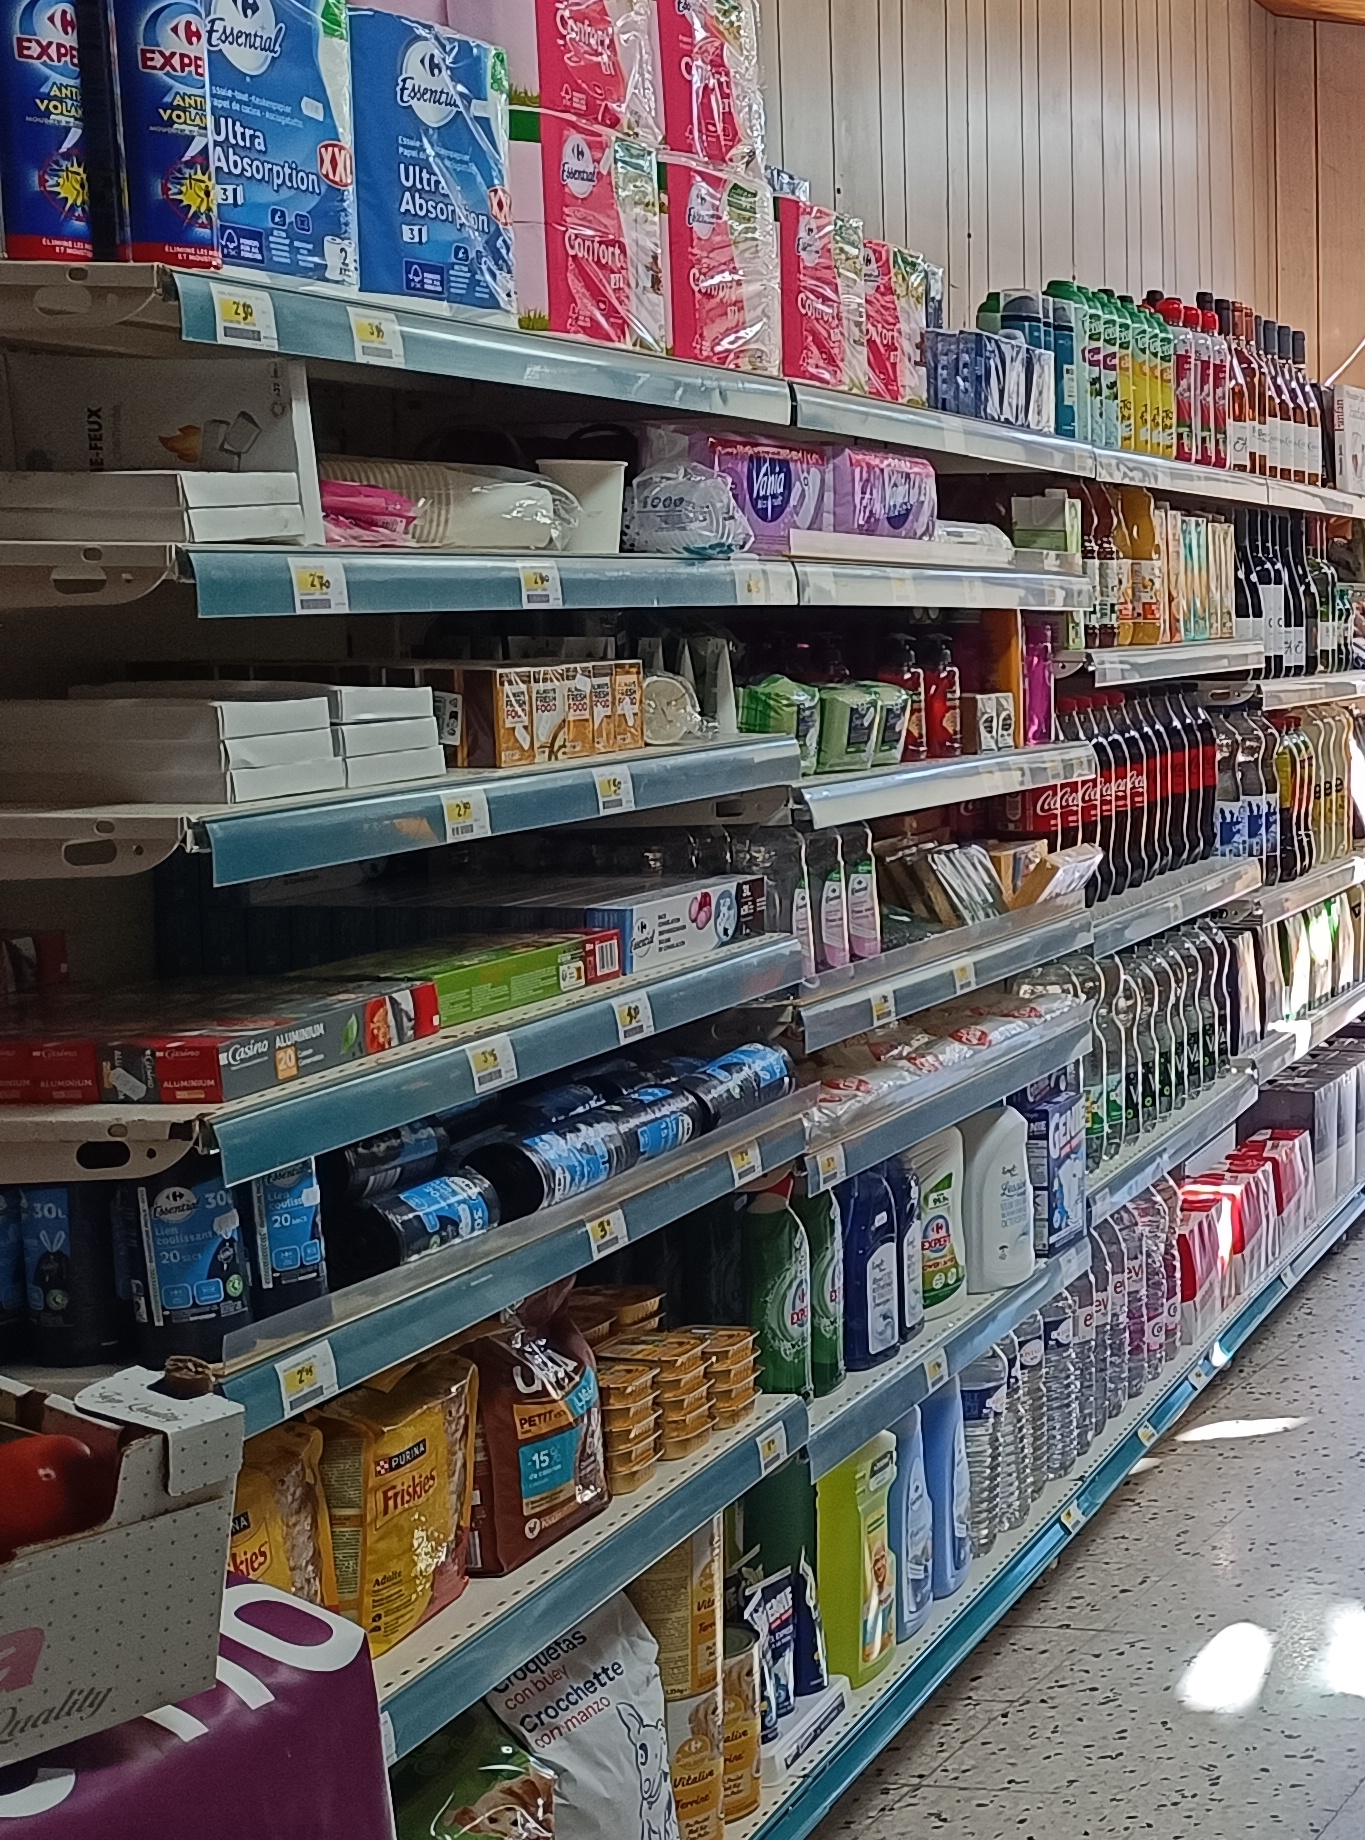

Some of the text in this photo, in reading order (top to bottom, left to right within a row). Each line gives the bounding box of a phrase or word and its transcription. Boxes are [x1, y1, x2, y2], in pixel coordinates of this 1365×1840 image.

[206, 17, 284, 55] Essential
[17, 38, 80, 67] EXPE
[140, 48, 204, 77] EXPE
[211, 115, 266, 153] Ultra
[214, 146, 321, 195] Absorption
[400, 163, 449, 196] Ultra
[275, 1022, 325, 1049] ALUMINIUM
[228, 1038, 269, 1065] Casino
[277, 1050, 296, 1071] 20
[163, 1079, 215, 1089] ALUMINIUM
[272, 1213, 291, 1228] 20
[159, 1251, 180, 1264] 20
[519, 1411, 553, 1430] PETIT
[391, 1441, 424, 1469] PURINA
[382, 1467, 437, 1518] Friskies
[231, 1540, 268, 1575] kies
[504, 1664, 570, 1711] con buey
[519, 1661, 625, 1734] Crocchette
[534, 1696, 611, 1749] con manzo
